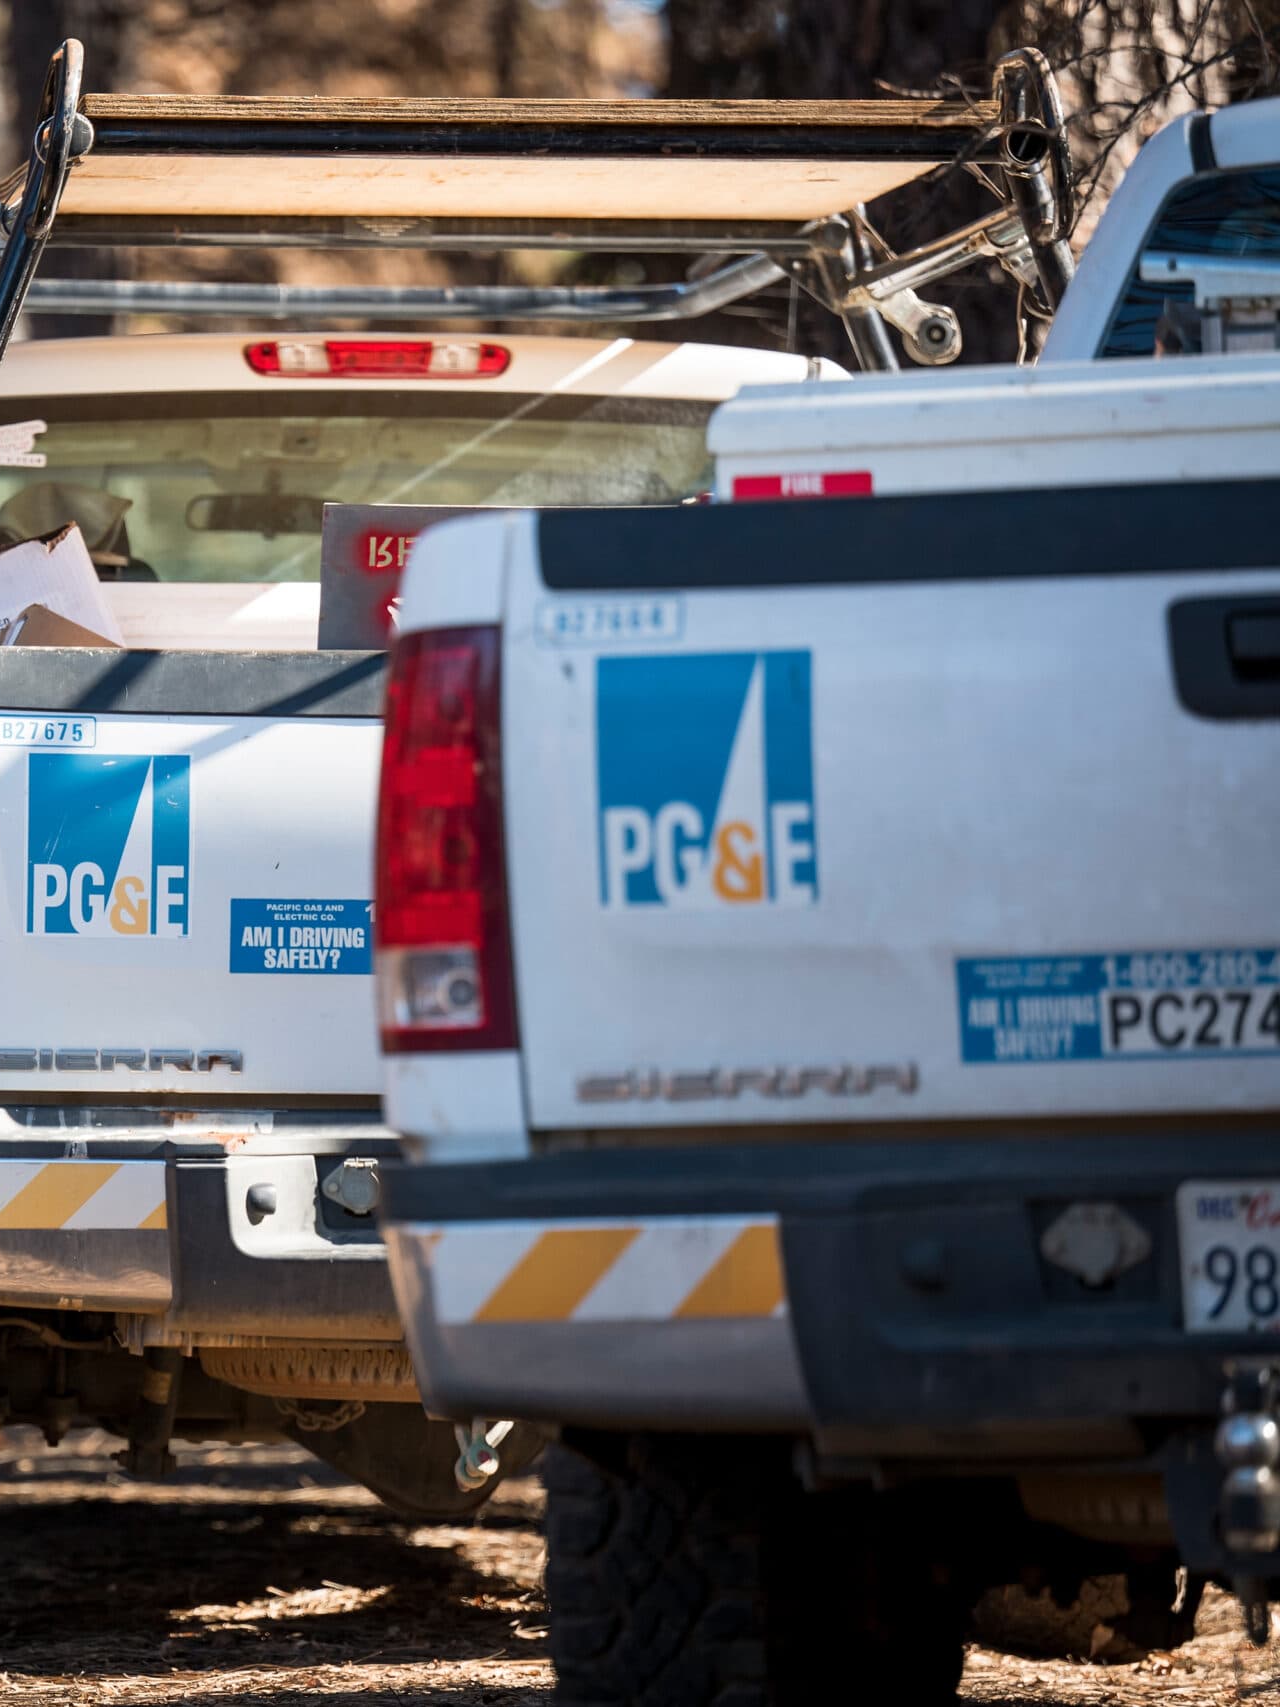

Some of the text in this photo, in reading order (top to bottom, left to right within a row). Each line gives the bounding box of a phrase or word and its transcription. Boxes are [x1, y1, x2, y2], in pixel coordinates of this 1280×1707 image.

[3, 722, 83, 741] B27675
[604, 801, 814, 907] PG&E
[33, 861, 185, 935] PG&E
[266, 903, 345, 912] PACIFIC GAS AND
[274, 913, 318, 921] ELECTRIC
[241, 926, 365, 948] AM I DRIVING
[264, 948, 341, 969] SAFELY?
